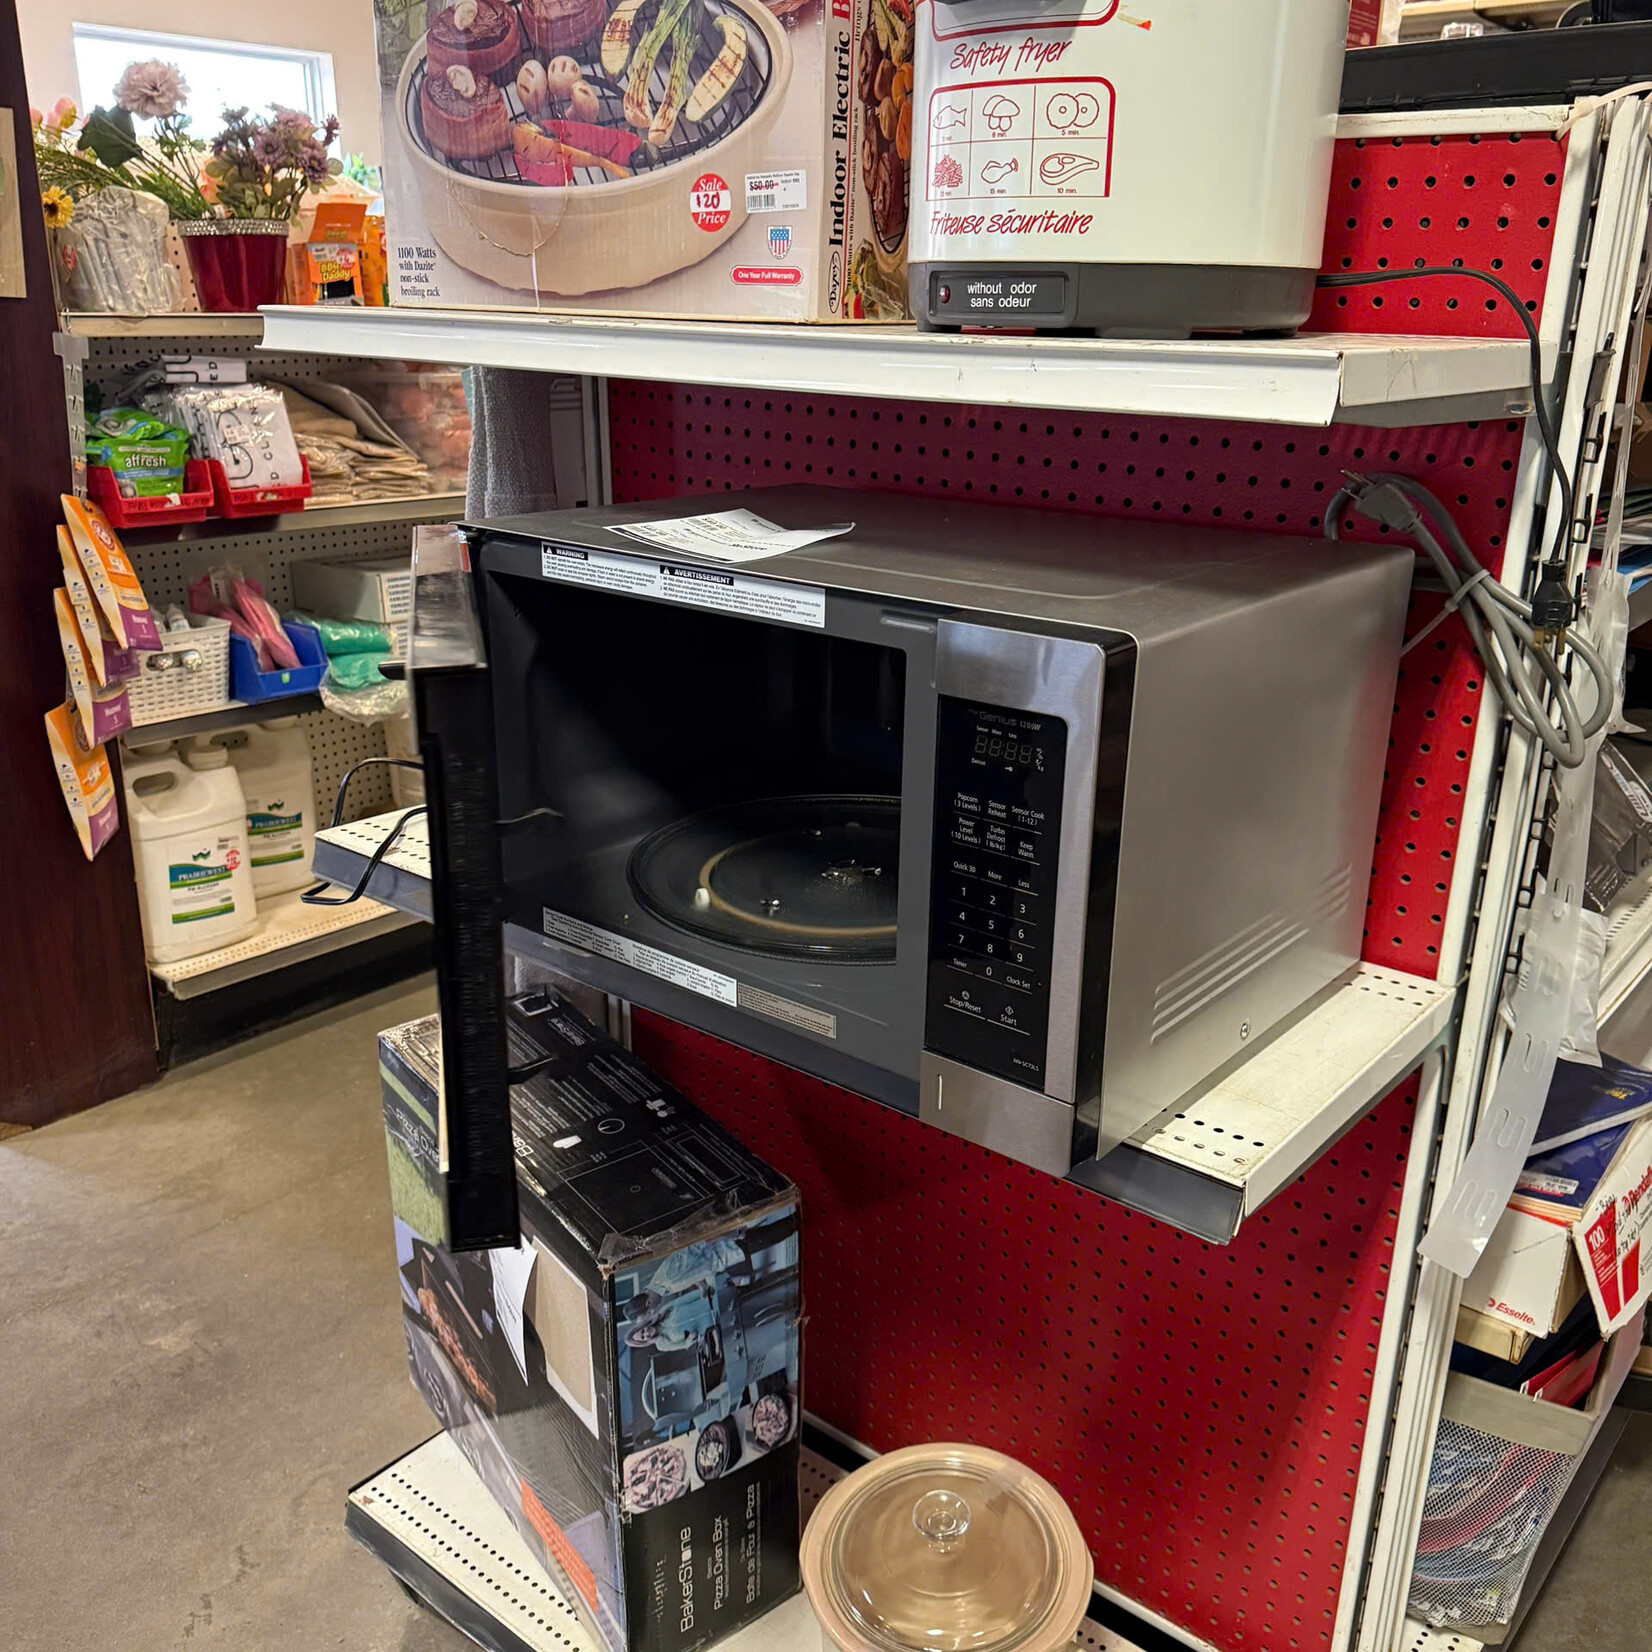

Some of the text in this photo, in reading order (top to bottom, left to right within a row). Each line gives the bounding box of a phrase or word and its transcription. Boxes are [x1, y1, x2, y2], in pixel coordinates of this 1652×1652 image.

[949, 36, 1073, 75] Safety fryer
[832, 31, 851, 142] Electric
[699, 178, 723, 191] Sale
[749, 179, 775, 192] $50.00
[828, 149, 848, 248] Indoor
[697, 211, 727, 225] Price
[929, 208, 1094, 236] Friteuse sécuritaire
[397, 247, 437, 259] 1100 Watts
[399, 260, 413, 271] with
[400, 272, 430, 283] non-stick
[738, 271, 796, 281] One Year Full Warranty
[426, 286, 441, 297] rack
[967, 280, 1038, 295] without odor
[970, 295, 1032, 308] sans odeur
[124, 451, 167, 469] affresh
[555, 547, 586, 560] WARNING
[674, 568, 732, 586] AVERTISSEMENT
[979, 711, 1017, 727] Genius
[957, 792, 979, 804] Popcorn
[988, 799, 1007, 811] Sensor
[987, 807, 1007, 819] Reheat
[1011, 805, 1046, 821] Sensor Cook
[958, 817, 976, 829] Power
[959, 826, 974, 836] Level
[990, 825, 1006, 836] Turbo
[986, 832, 1006, 844] Defrost
[1019, 840, 1034, 852] Keep
[1017, 848, 1036, 860] Warm
[953, 861, 968, 872] Quick
[987, 870, 1003, 881] More
[1018, 879, 1030, 889] Less
[961, 887, 966, 897] 1
[989, 895, 996, 905] 2
[1019, 903, 1026, 914] 3
[959, 911, 966, 921] 4
[988, 919, 995, 930] 5
[959, 934, 965, 944] 7
[1018, 928, 1025, 939] 6
[987, 943, 993, 954] 8
[1016, 952, 1023, 963] 9
[986, 966, 992, 977] 0
[1006, 974, 1031, 990] Clock Set
[949, 995, 982, 1014] Stop/Reset
[1000, 1013, 1018, 1026] Start
[1587, 1225, 1605, 1248] 100
[746, 1483, 756, 1519] Pizza
[713, 1515, 724, 1611] Pizza Oven Box
[678, 1525, 695, 1633] BakerStone
